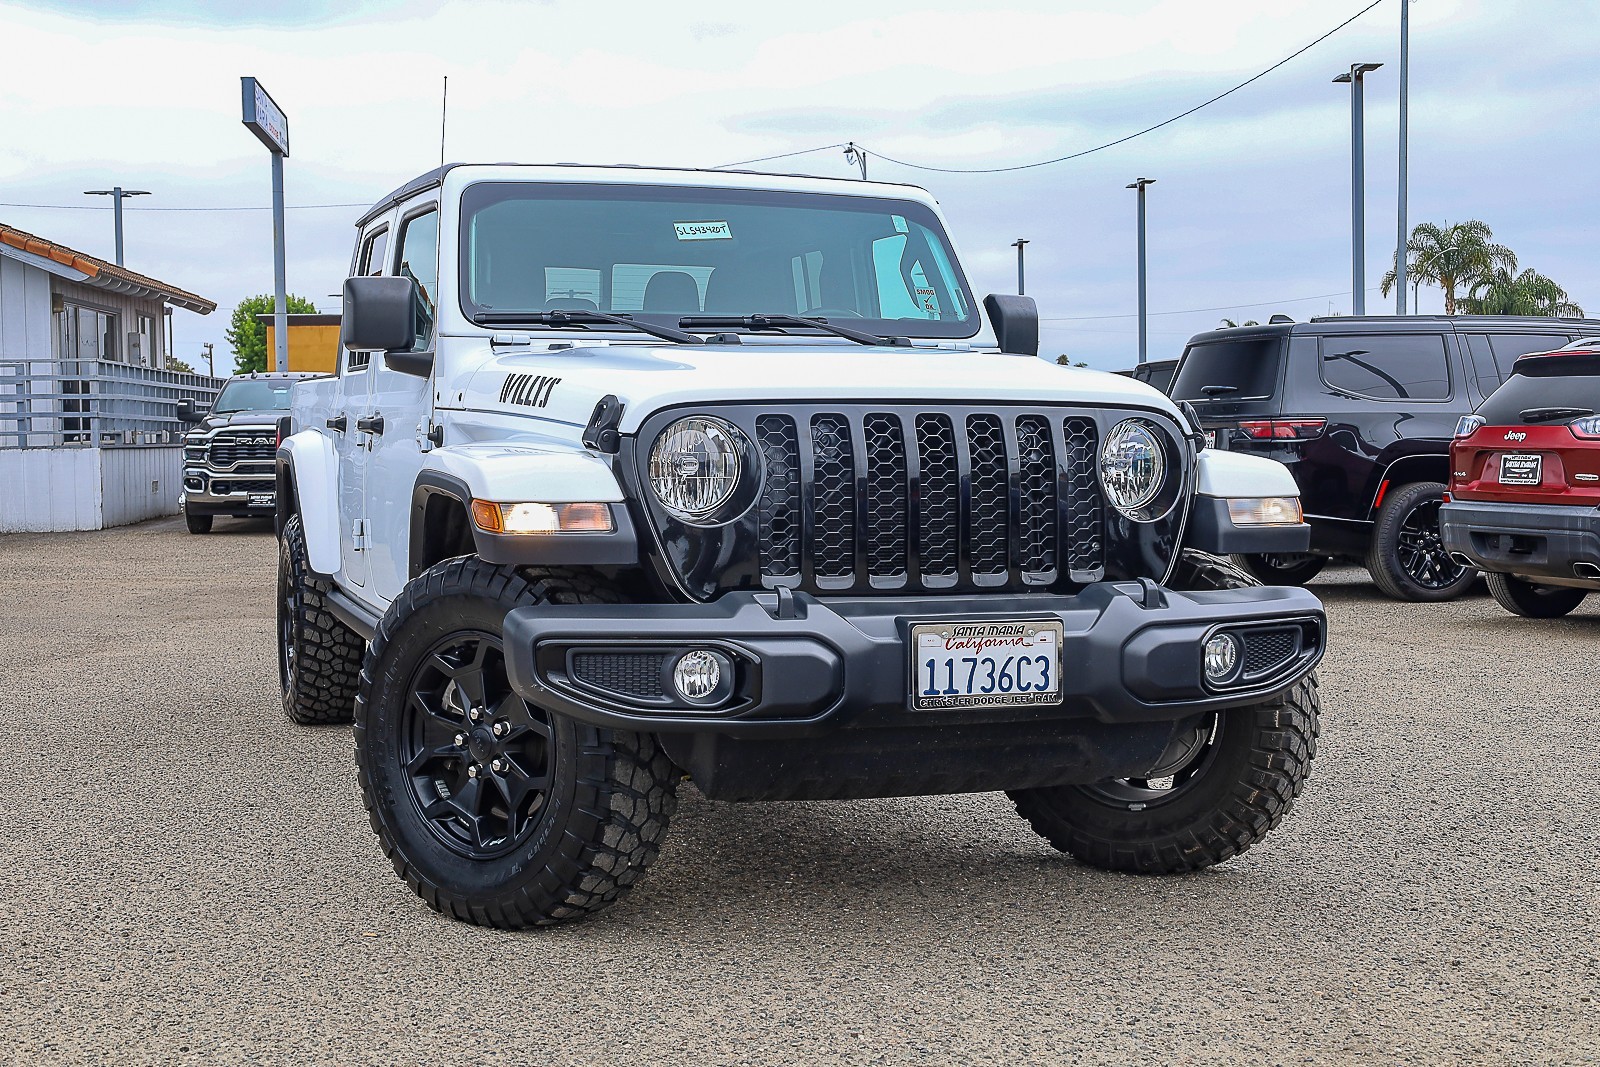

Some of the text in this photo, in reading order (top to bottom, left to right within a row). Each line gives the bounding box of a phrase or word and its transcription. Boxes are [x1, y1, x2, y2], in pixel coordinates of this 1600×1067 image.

[499, 373, 562, 408] WILLYS
[1504, 430, 1526, 442] Jeep
[952, 625, 1025, 637] SANTA MARIA
[945, 637, 1033, 655] California
[923, 655, 1050, 696] 11736C3
[920, 697, 972, 707] CHRYSLER
[974, 695, 1007, 705] DODGE
[1035, 693, 1057, 703] RAM
